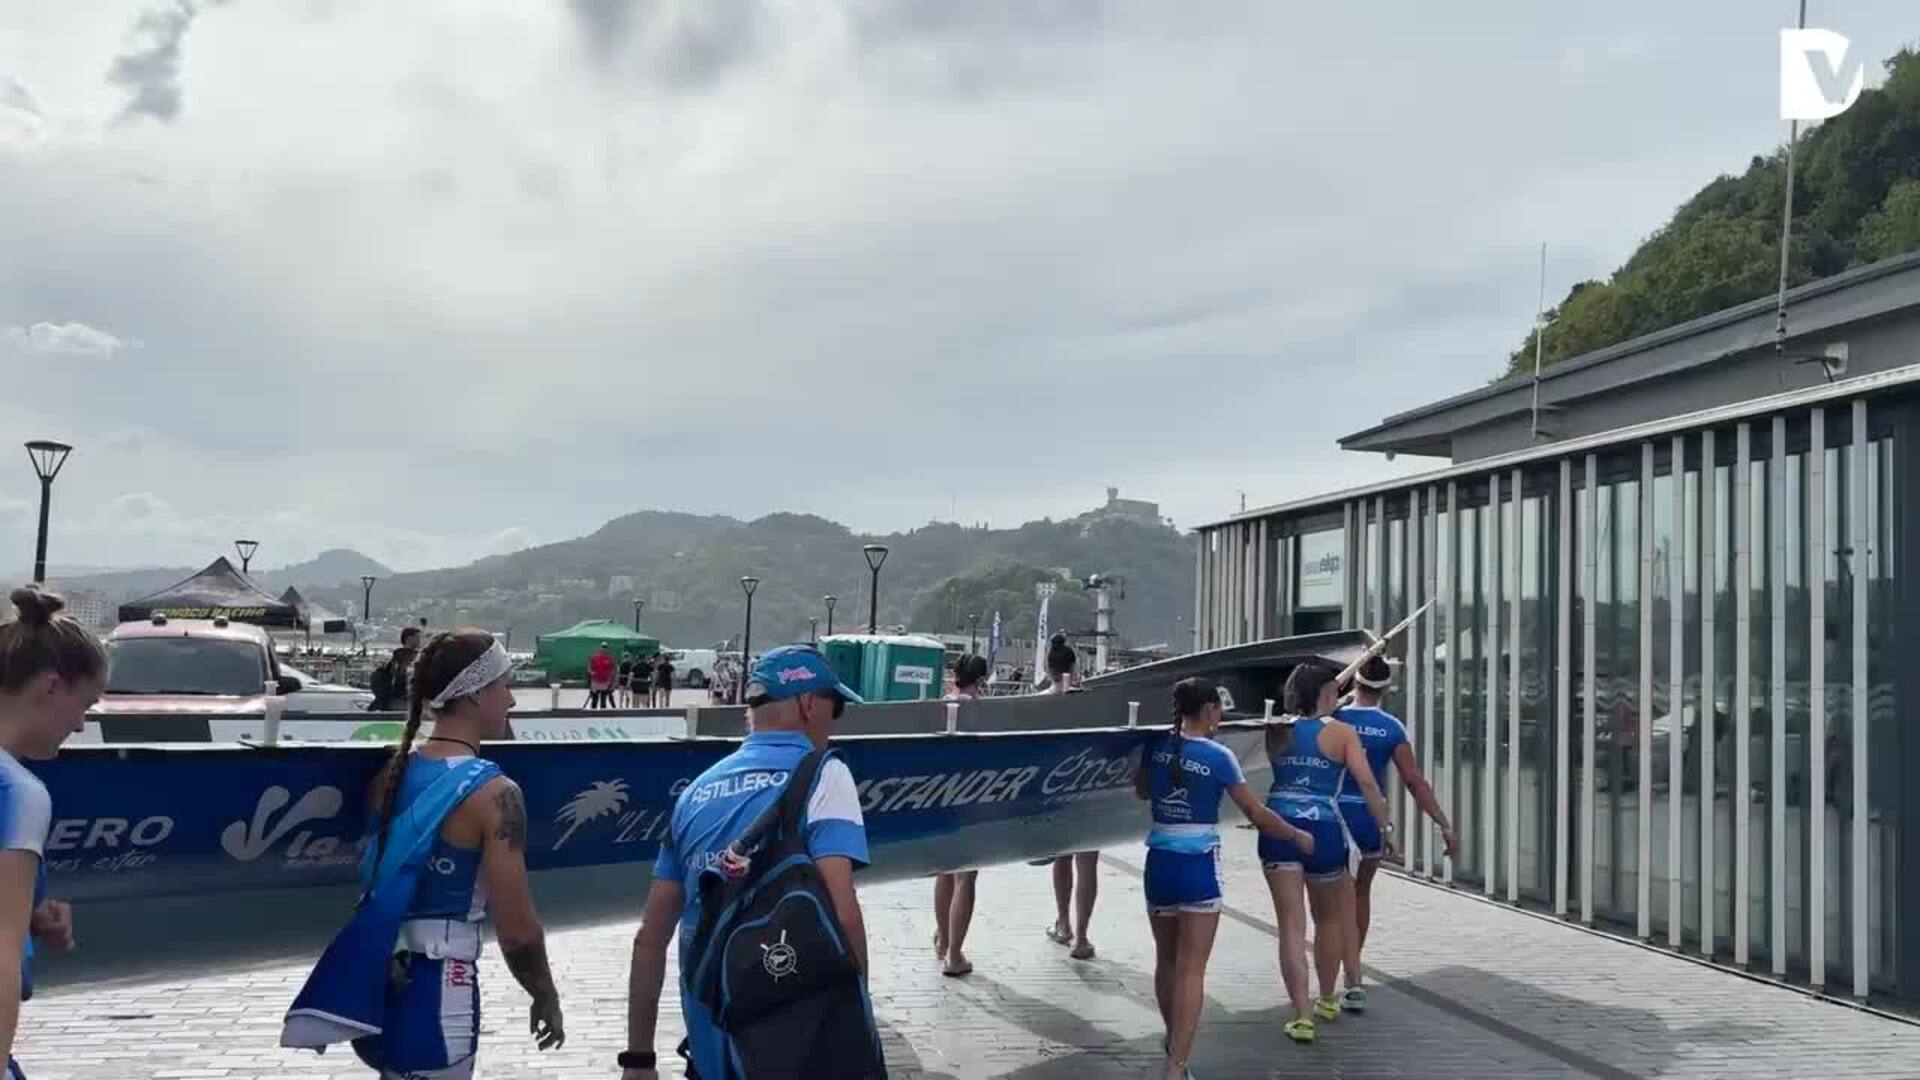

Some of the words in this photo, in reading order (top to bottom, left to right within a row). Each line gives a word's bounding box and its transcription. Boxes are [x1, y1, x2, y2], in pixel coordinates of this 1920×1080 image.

[1277, 756, 1330, 769] STILLERO
[690, 771, 789, 804] ASTILLERO
[46, 815, 175, 851] ERO
